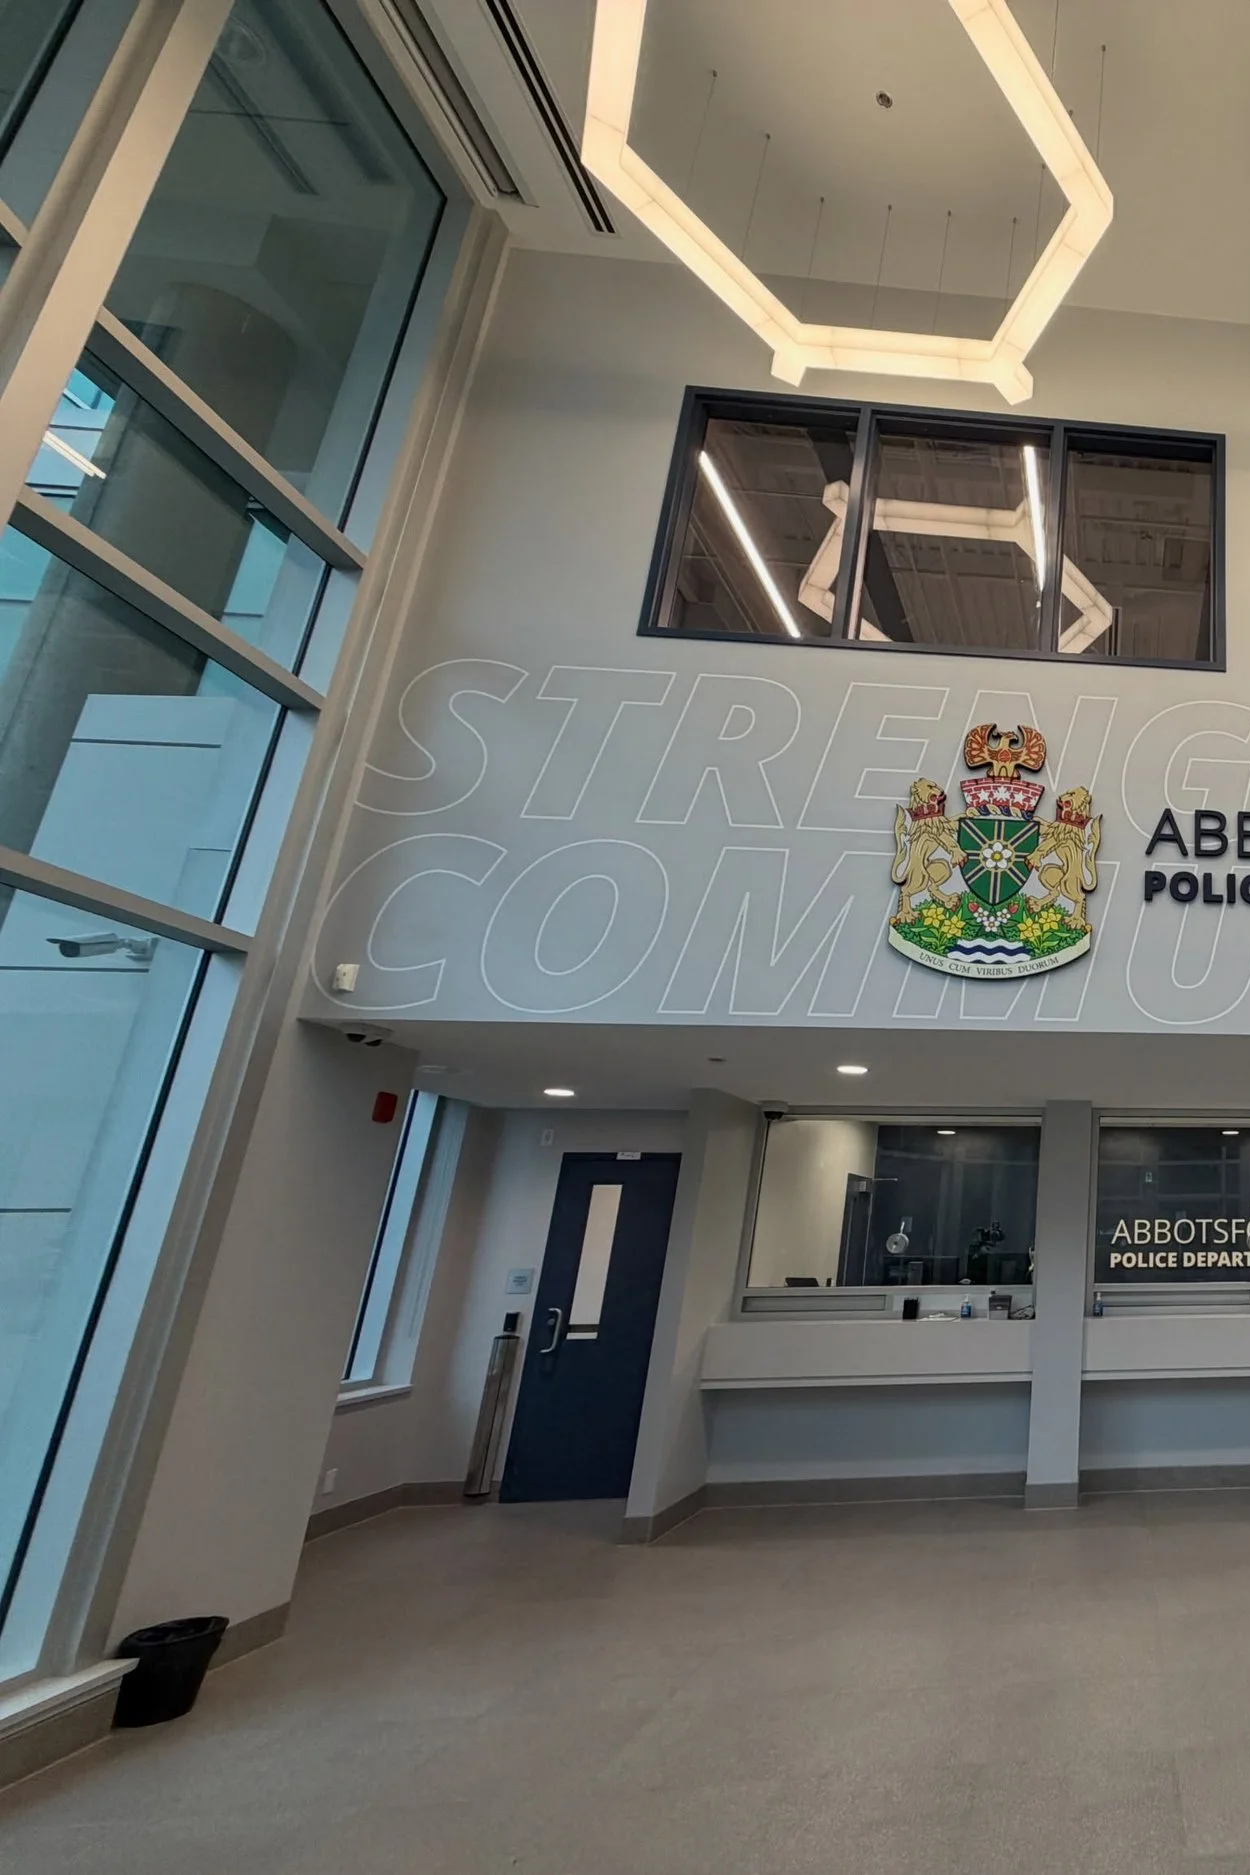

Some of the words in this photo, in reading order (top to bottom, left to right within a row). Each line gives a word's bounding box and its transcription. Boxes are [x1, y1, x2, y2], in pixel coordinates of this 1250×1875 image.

[919, 952, 945, 967] UNUS
[948, 963, 970, 974] CUM
[976, 967, 1013, 976] VIRIBUS
[1018, 956, 1059, 974] DUORUM
[1109, 1252, 1177, 1268] POLICE
